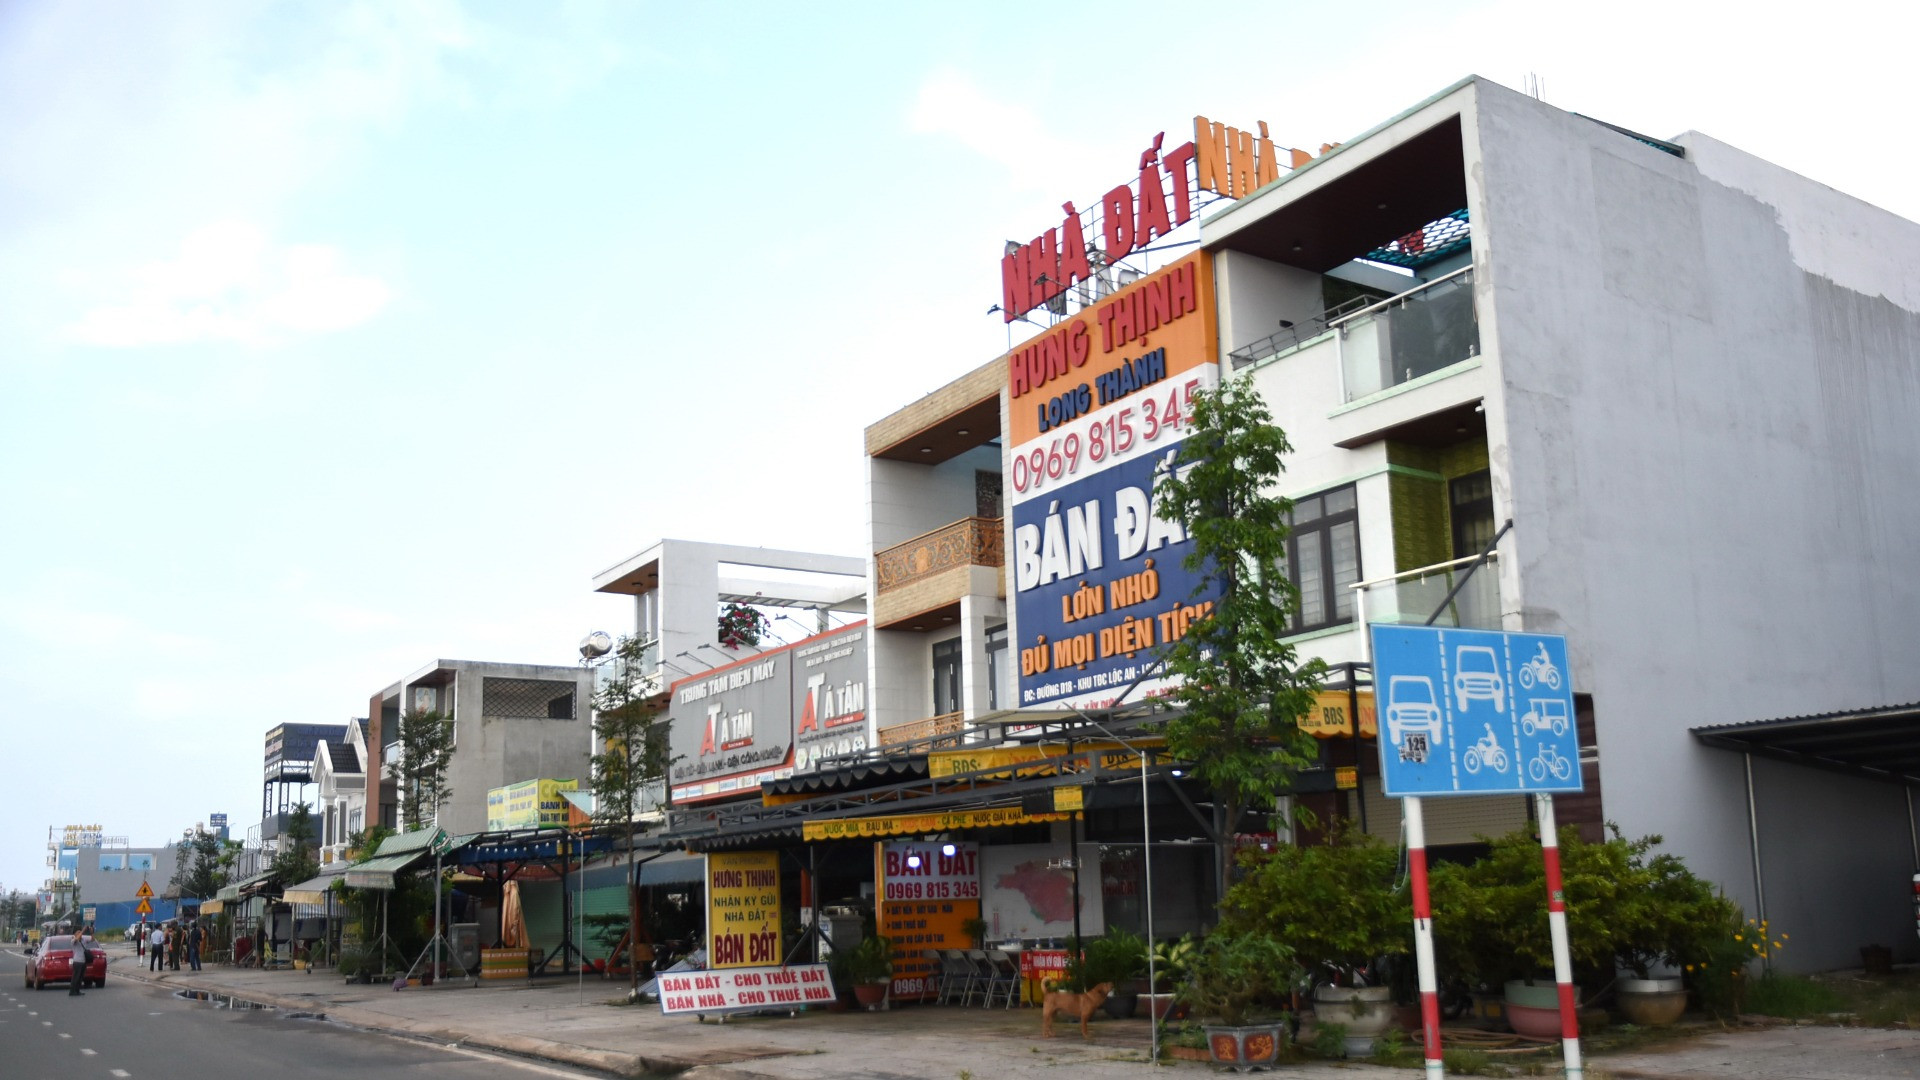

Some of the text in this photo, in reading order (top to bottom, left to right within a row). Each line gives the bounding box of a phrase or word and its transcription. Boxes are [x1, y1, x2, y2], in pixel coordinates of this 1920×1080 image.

[1194, 115, 1279, 200] NHÀ
[1001, 131, 1195, 323] NHÀ ĐẤT
[1010, 261, 1196, 399] HƯNG THỊNH
[1038, 346, 1166, 432] LONG THÀNH
[1013, 432, 1080, 493] 0969
[1088, 407, 1133, 462] 815
[1015, 499, 1103, 592] BÁN
[1062, 558, 1159, 624] LỚN NHỎ
[1022, 634, 1049, 677] ĐỦ
[1053, 632, 1096, 671] MỌI
[1100, 616, 1154, 659] DIỆN
[680, 658, 776, 704] TRUNG TÂM ĐIỆN MÁY
[837, 680, 864, 715] TÂN
[1077, 676, 1092, 691] KHU
[1124, 667, 1136, 680] AN
[731, 709, 753, 740] TÂN
[745, 869, 776, 891] THỊNH
[886, 846, 931, 876] BÁN
[887, 881, 978, 899] 0969 815 345
[715, 921, 777, 964] BÁN ĐẤT
[664, 975, 691, 991] BÁN
[695, 972, 721, 989] ĐẤT
[734, 974, 761, 986] CHO
[801, 967, 825, 982] ĐẤT
[667, 994, 695, 1010] BÁN
[698, 992, 726, 1007] NHÀ
[738, 991, 766, 1004] CHO
[769, 986, 801, 1002] THUÊ
[804, 985, 831, 999] NHÀ
[894, 978, 923, 994] 0969
